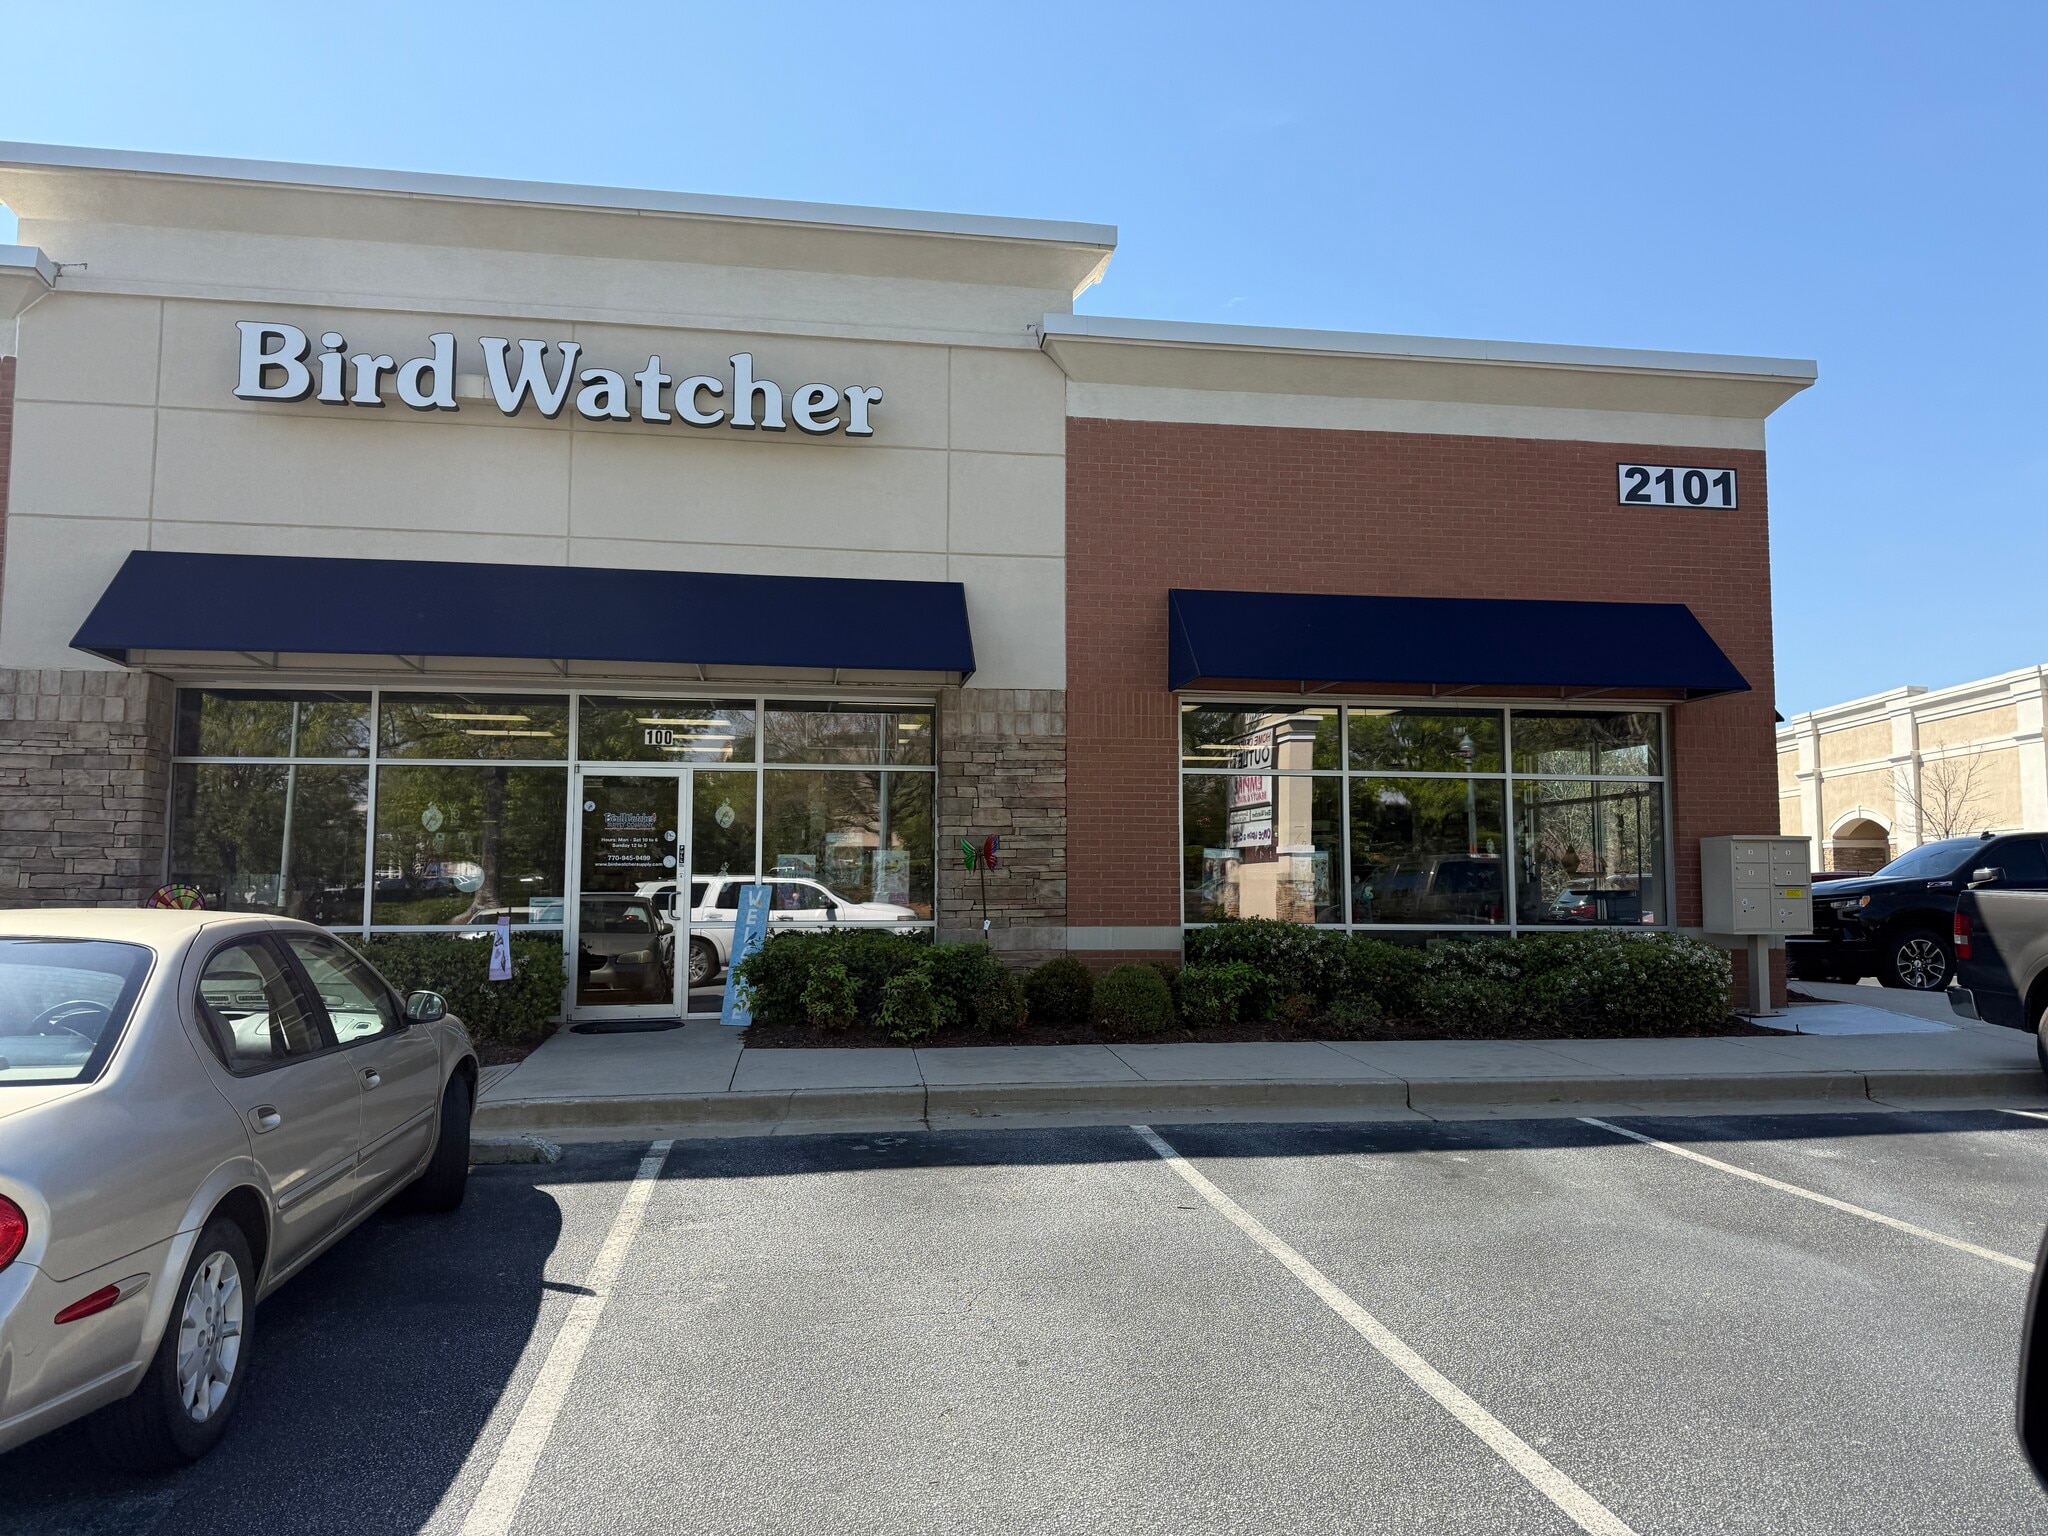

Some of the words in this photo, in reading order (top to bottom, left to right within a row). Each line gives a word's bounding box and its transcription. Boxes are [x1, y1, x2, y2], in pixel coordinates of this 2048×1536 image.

[232, 320, 459, 411] Bird
[478, 336, 883, 437] Watcher
[1624, 466, 1732, 507] 2101
[647, 730, 672, 745] 100
